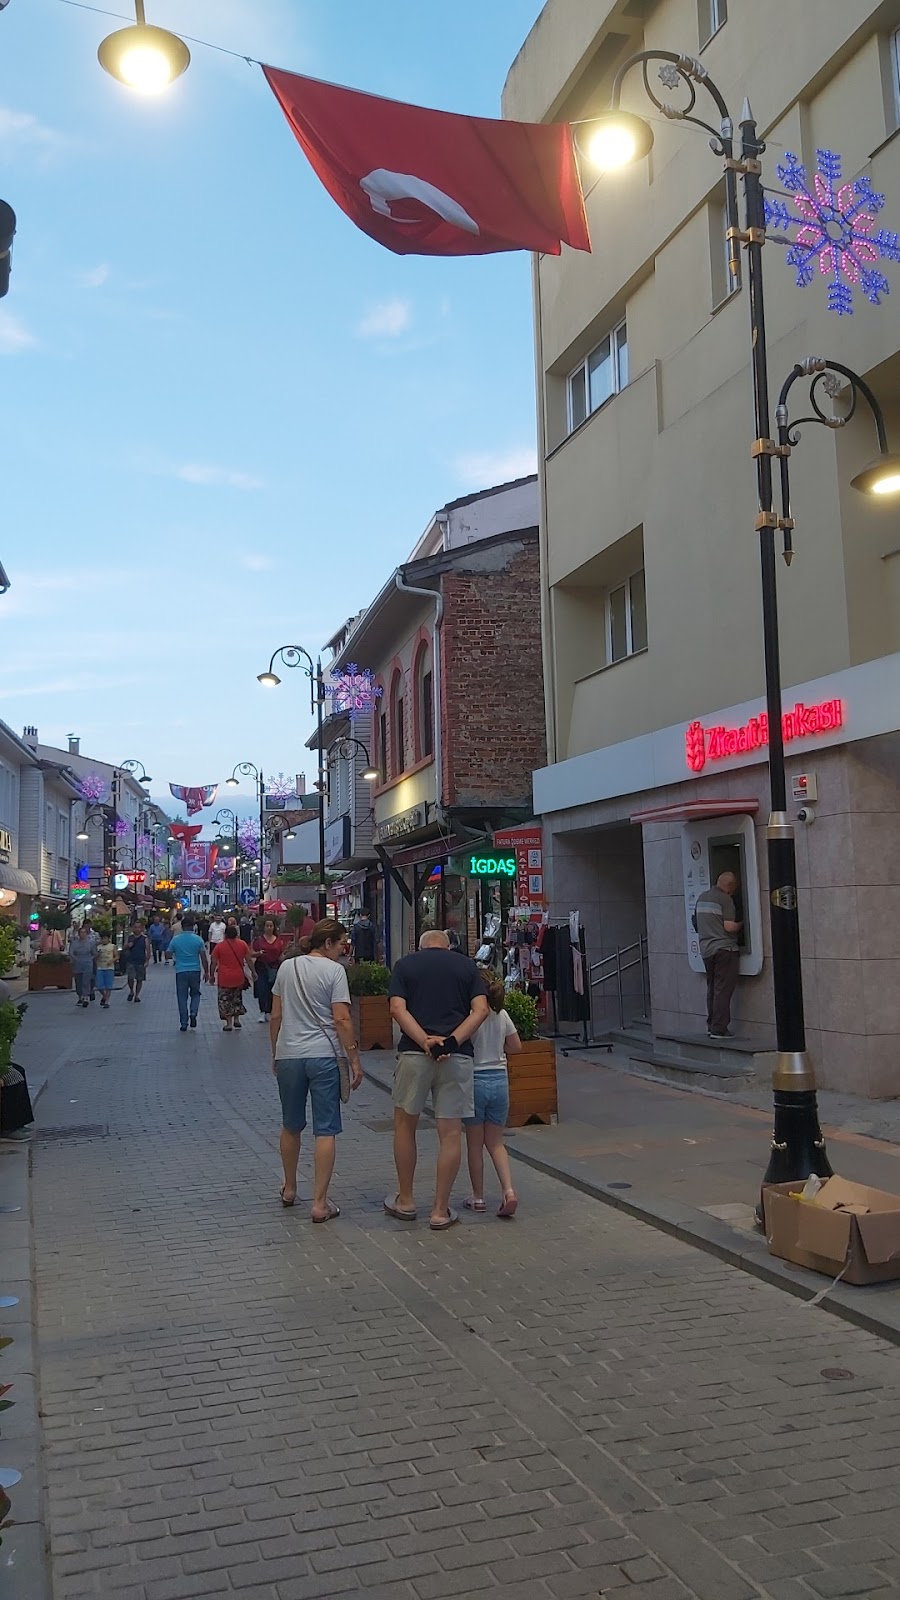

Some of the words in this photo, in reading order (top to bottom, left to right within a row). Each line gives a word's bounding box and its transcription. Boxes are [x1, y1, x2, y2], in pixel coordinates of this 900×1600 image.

[705, 718, 759, 758] Ziraat
[758, 700, 842, 741] Bnkası
[470, 857, 515, 876] İGDAŞ
[518, 851, 528, 889] FATURA
